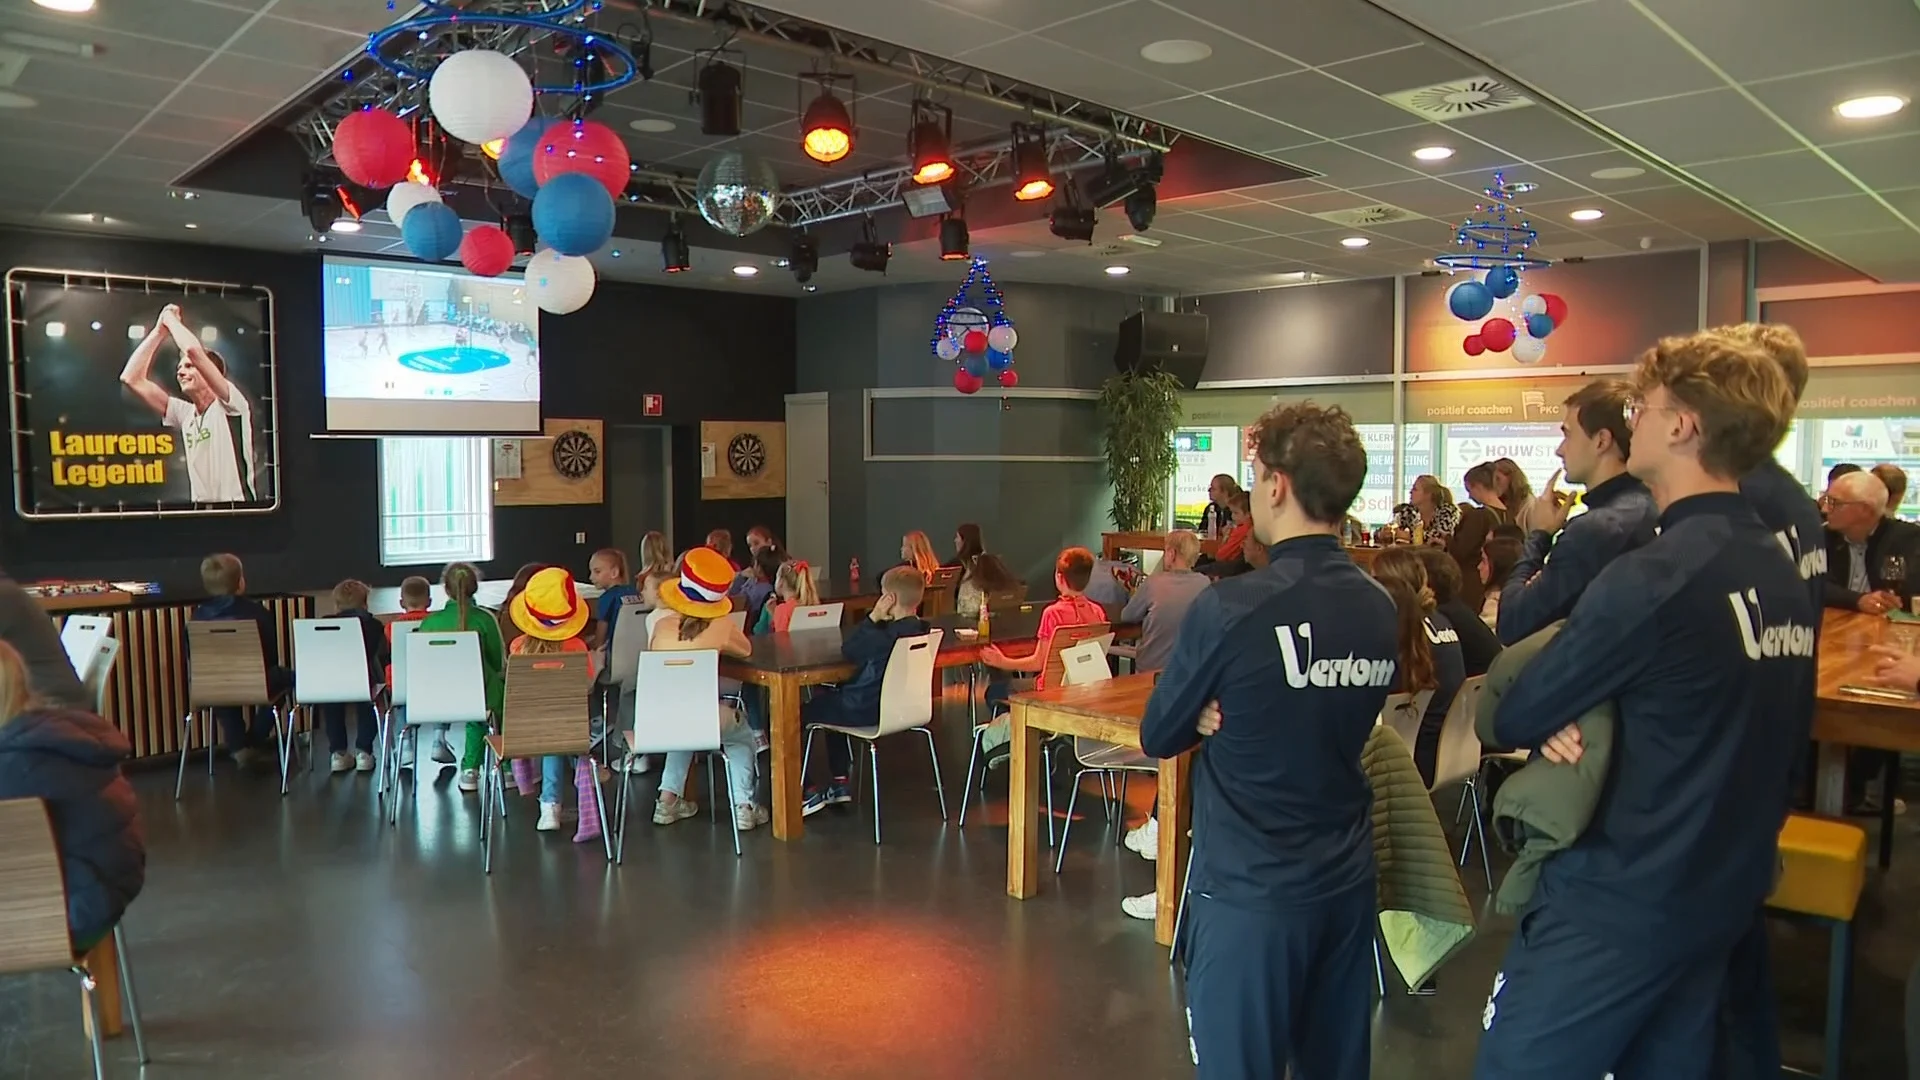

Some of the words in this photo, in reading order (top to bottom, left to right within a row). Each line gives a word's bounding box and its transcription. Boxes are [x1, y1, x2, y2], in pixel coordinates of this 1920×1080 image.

[1427, 405, 1465, 417] positief
[1467, 404, 1513, 415] coachen
[1540, 405, 1560, 414] PKC
[1800, 397, 1846, 409] ositief
[1850, 395, 1916, 408] coachen
[49, 430, 175, 456] Laurens
[1830, 439, 1849, 449] De
[52, 459, 165, 488] Legend
[1421, 616, 1459, 644] Verto
[1274, 622, 1396, 689] Vertom
